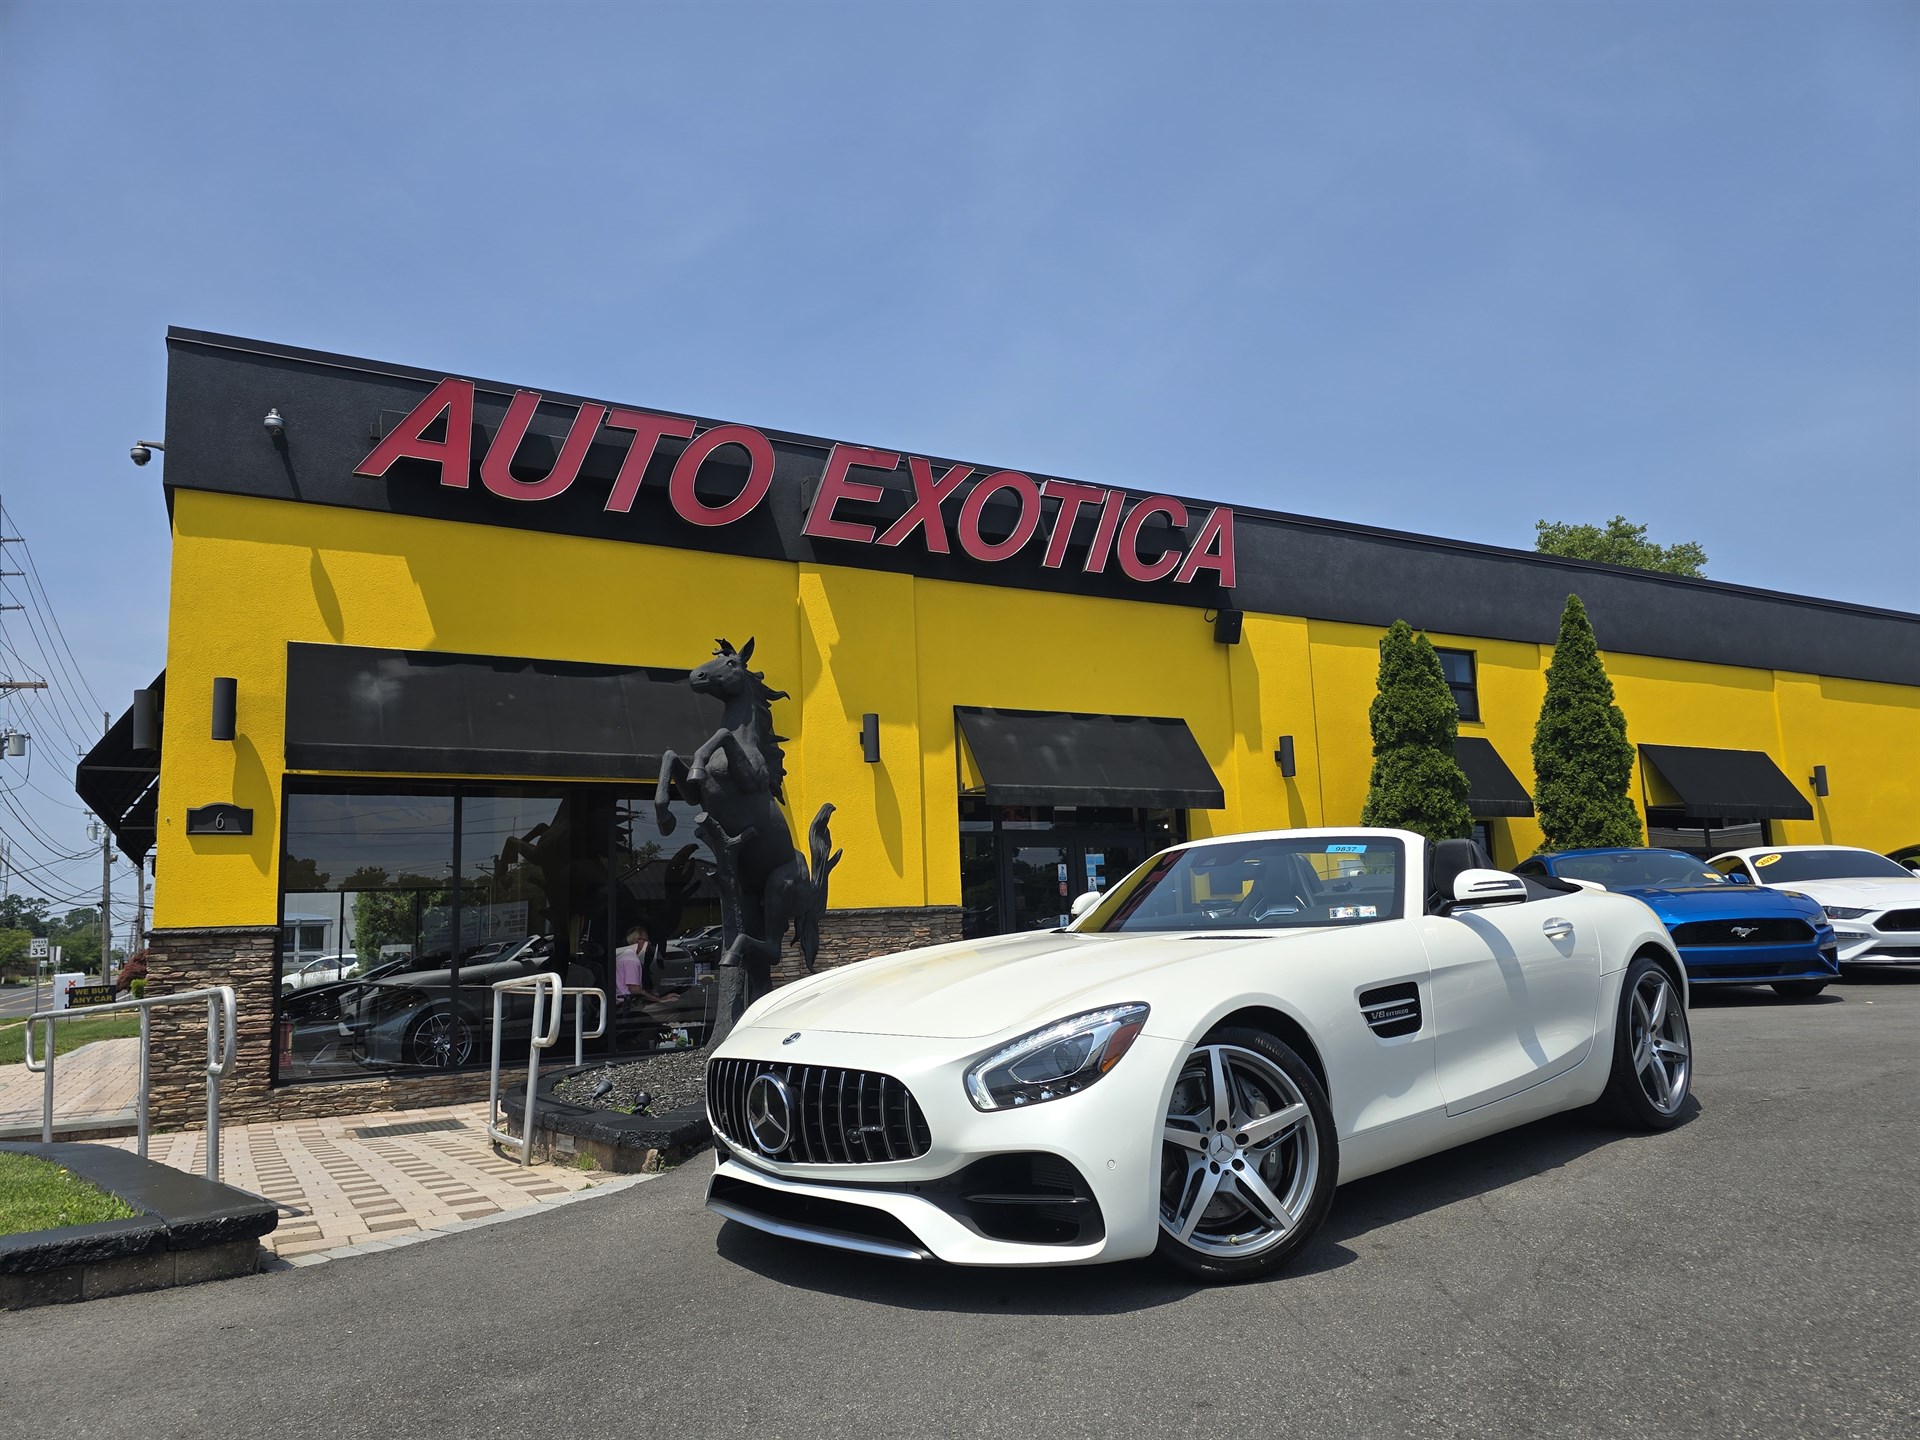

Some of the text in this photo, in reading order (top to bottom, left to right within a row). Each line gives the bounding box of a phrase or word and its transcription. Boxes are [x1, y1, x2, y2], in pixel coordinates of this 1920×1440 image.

[352, 376, 1236, 589] AUTO EXOTICA
[215, 812, 224, 829] 6
[1371, 1010, 1386, 1020] V8
